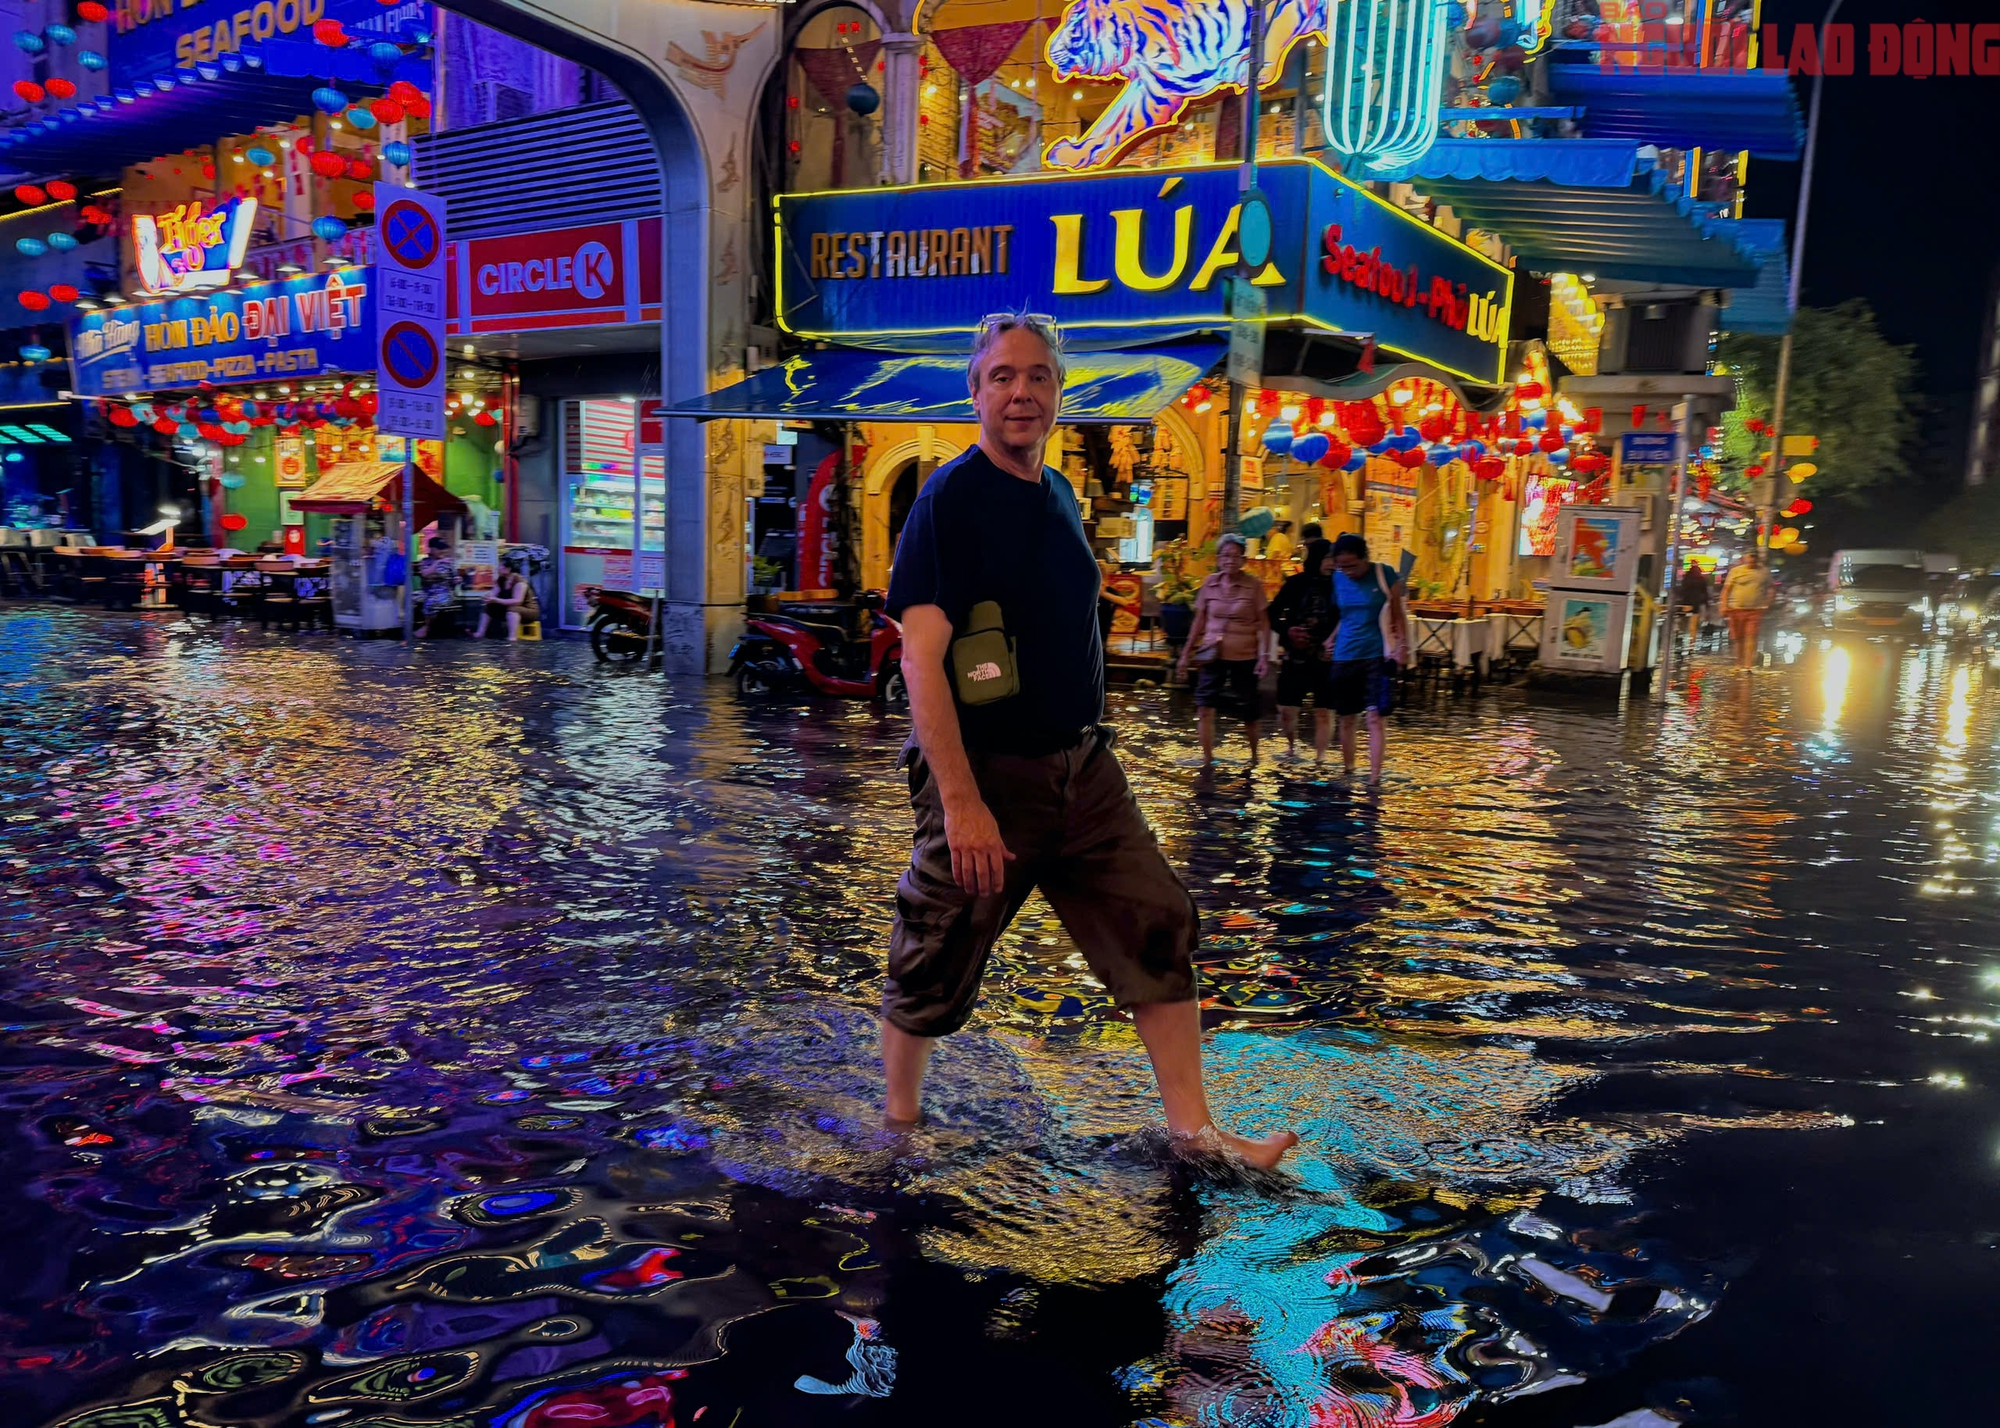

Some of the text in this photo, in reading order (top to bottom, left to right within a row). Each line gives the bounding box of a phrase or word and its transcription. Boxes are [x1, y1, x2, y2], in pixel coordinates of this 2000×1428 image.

[175, 0, 325, 68] SEAFOOD
[810, 177, 1286, 294] RESTAURANT LÚA
[478, 257, 573, 296] CIRCLE
[577, 246, 613, 297] K
[189, 305, 240, 347] ĐẢO
[242, 300, 290, 348] ĐẠI
[295, 274, 367, 340] VIỆT
